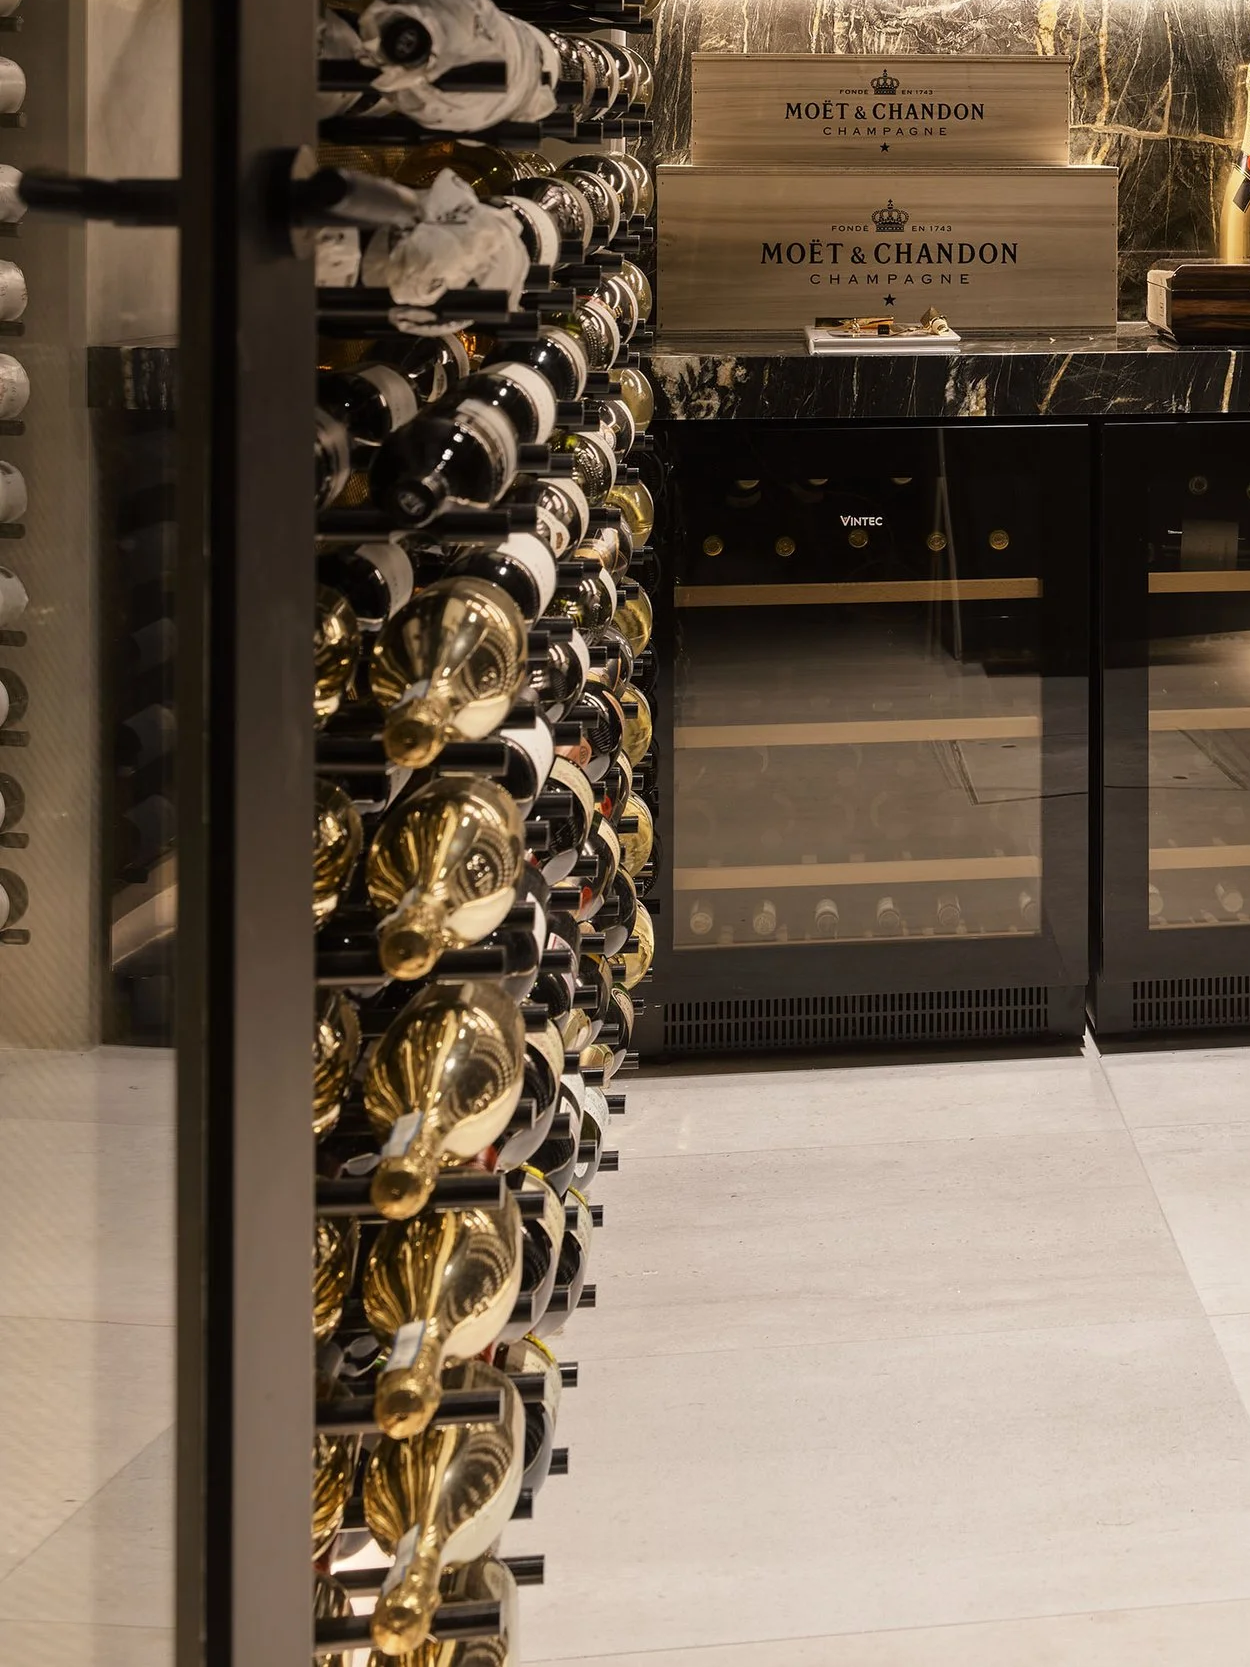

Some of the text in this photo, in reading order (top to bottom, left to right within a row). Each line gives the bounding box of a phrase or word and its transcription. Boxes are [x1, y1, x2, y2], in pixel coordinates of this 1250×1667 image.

[785, 100, 984, 120] MOËT & CHANDON
[823, 127, 947, 136] CHAMPAGNE
[832, 223, 869, 232] FONDÉ
[761, 239, 1018, 265] MOËT & CHANDON
[810, 274, 970, 284] CHAMPAGNE
[840, 515, 883, 526] VINTEC
